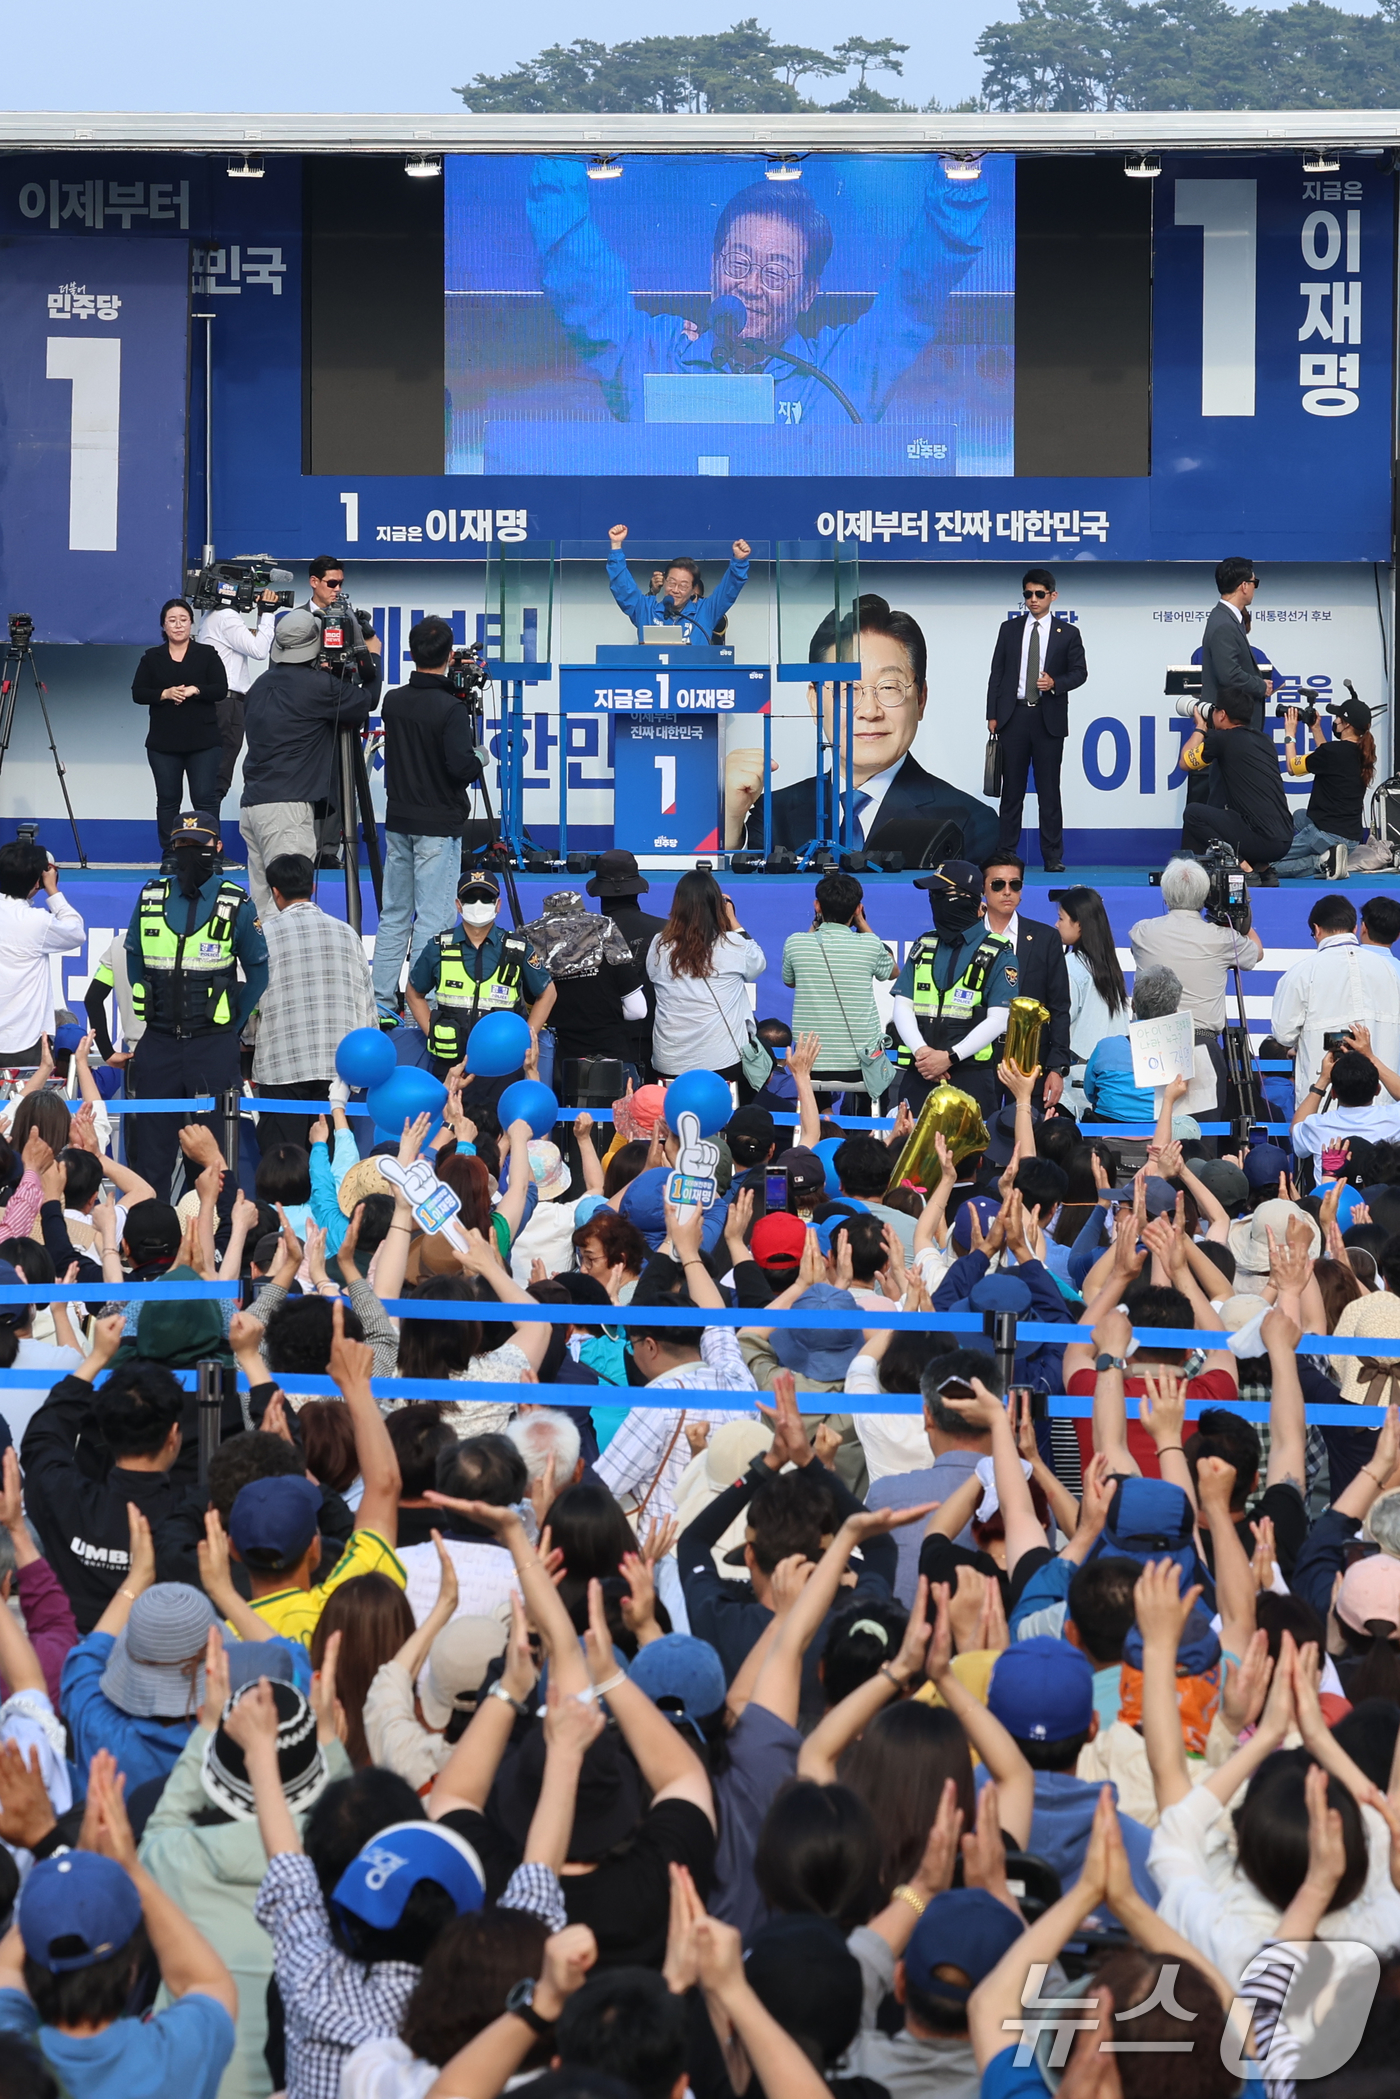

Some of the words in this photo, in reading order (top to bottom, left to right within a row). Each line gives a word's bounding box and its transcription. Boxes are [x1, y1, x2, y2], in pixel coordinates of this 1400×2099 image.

[18, 179, 190, 230] 이제부터
[1302, 180, 1363, 201] 지금은
[192, 244, 287, 296] 민국
[47, 294, 122, 321] 민주당
[1174, 178, 1258, 416] 1
[1298, 209, 1362, 417] 이재명
[45, 336, 122, 552] 1
[906, 444, 948, 460] 민주당
[340, 492, 359, 542] 1
[376, 526, 423, 542] 지금은
[425, 509, 528, 543] 이재명
[816, 509, 929, 543] 이제부터
[934, 509, 992, 543] 진짜
[995, 509, 1110, 543] 대한민국
[1255, 610, 1308, 622] 대통령선거
[1311, 610, 1332, 622] 후보
[594, 689, 654, 709] 지금은
[655, 673, 670, 709] 1
[676, 689, 735, 709] 이재명
[1265, 675, 1333, 703] 금은
[630, 726, 654, 740] 진짜
[656, 726, 703, 740] 대한민국
[654, 755, 676, 815] 1
[653, 838, 678, 848] 민주당
[955, 989, 974, 1000] 경찰
[671, 1177, 683, 1199] 1
[682, 1187, 712, 1203] 이재명
[420, 1208, 437, 1228] 1
[70, 1536, 134, 1565] UMB
